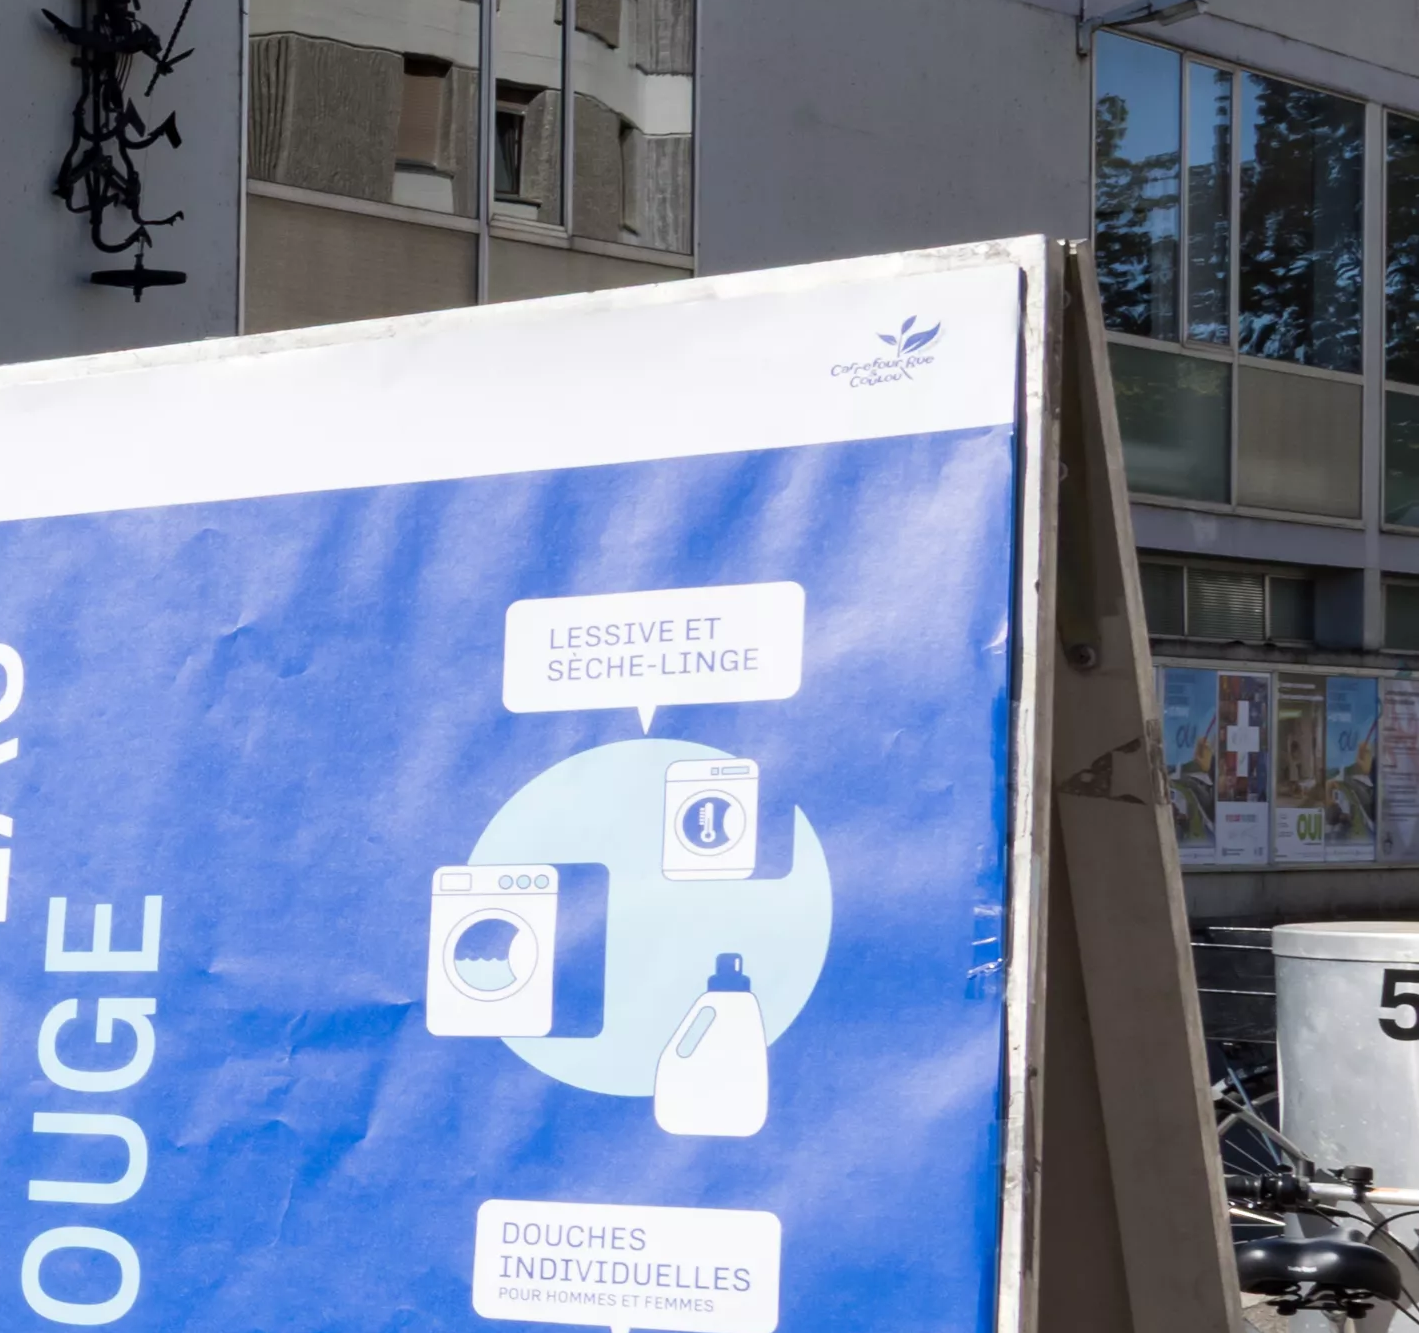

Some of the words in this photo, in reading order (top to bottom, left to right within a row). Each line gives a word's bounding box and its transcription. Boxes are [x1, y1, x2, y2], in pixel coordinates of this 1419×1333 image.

[549, 620, 675, 650] LESSIVE
[686, 617, 721, 641] ET
[547, 648, 759, 682] SÈCHE-LINGE
[1378, 969, 1419, 1041] 5
[502, 1222, 647, 1251] DOUCHES
[499, 1255, 751, 1292] INDIVIDUELLES
[499, 1286, 541, 1302] POUR
[546, 1290, 617, 1307] HOMMES
[622, 1294, 640, 1308] ET
[645, 1296, 714, 1313] FEMMES
